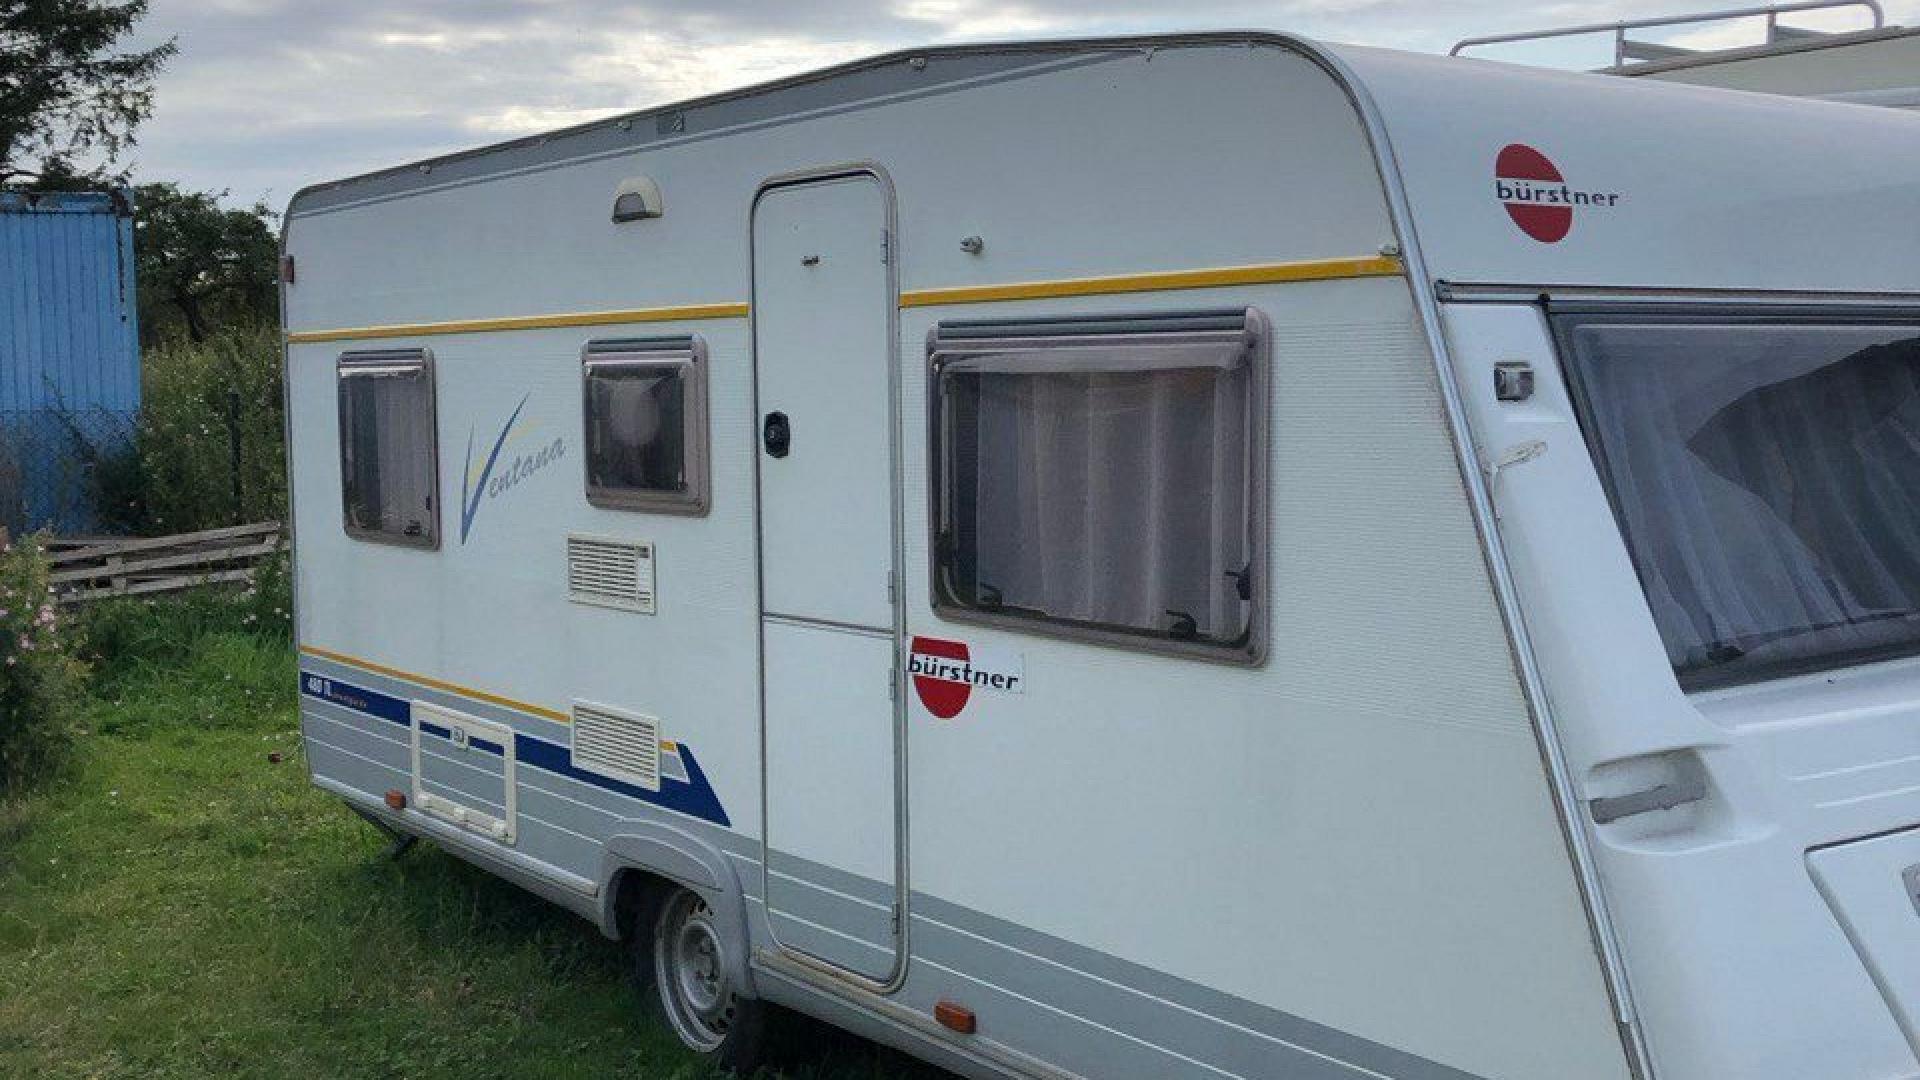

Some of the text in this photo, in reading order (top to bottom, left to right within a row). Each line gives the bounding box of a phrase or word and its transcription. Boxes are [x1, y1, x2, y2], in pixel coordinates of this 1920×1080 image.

[1496, 180, 1619, 206] bürstner
[461, 392, 567, 545] Ventana
[908, 653, 1019, 690] bürstner
